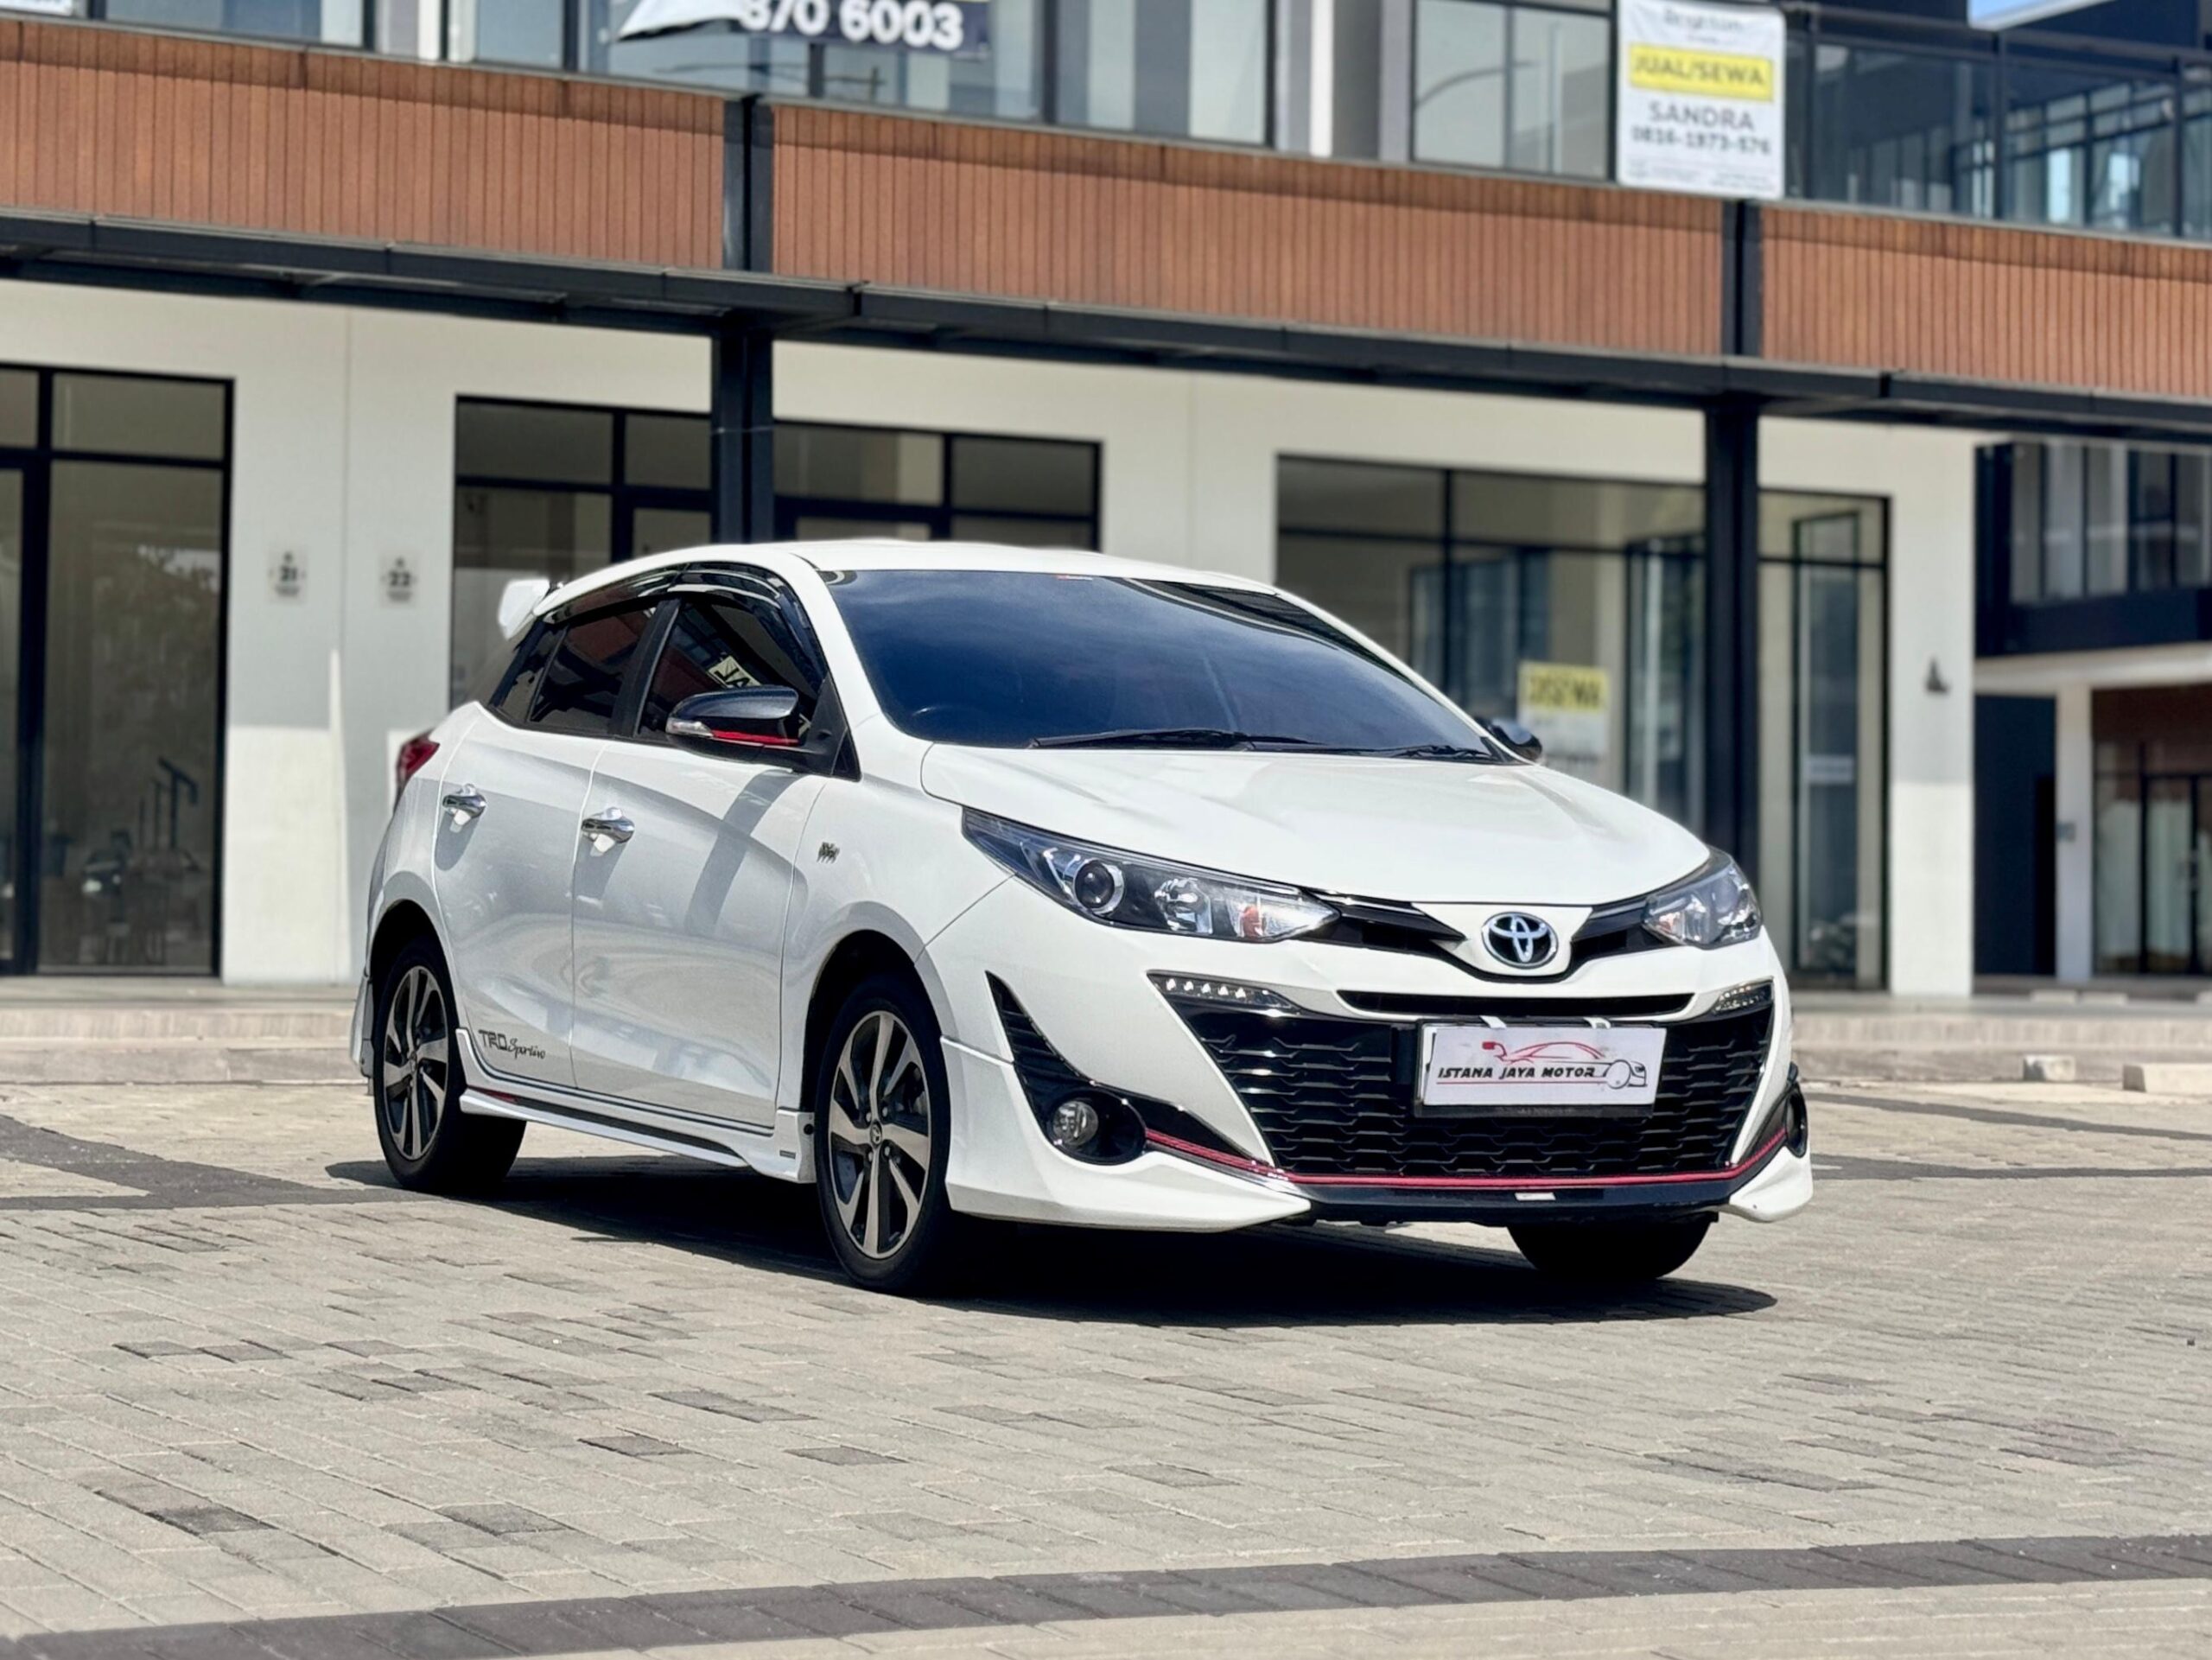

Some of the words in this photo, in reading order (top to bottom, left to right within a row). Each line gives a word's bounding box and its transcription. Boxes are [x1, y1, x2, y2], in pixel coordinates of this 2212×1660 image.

[838, 0, 963, 50] 6003
[1635, 55, 1766, 85] JUAL/SEWA
[1648, 101, 1755, 130] SANDRA
[478, 1028, 508, 1051] TRD
[506, 1037, 546, 1060] Sportivo
[1438, 1067, 1493, 1078] ISTANA
[1498, 1067, 1535, 1080] JAYA
[1541, 1067, 1596, 1078] MOTOR
